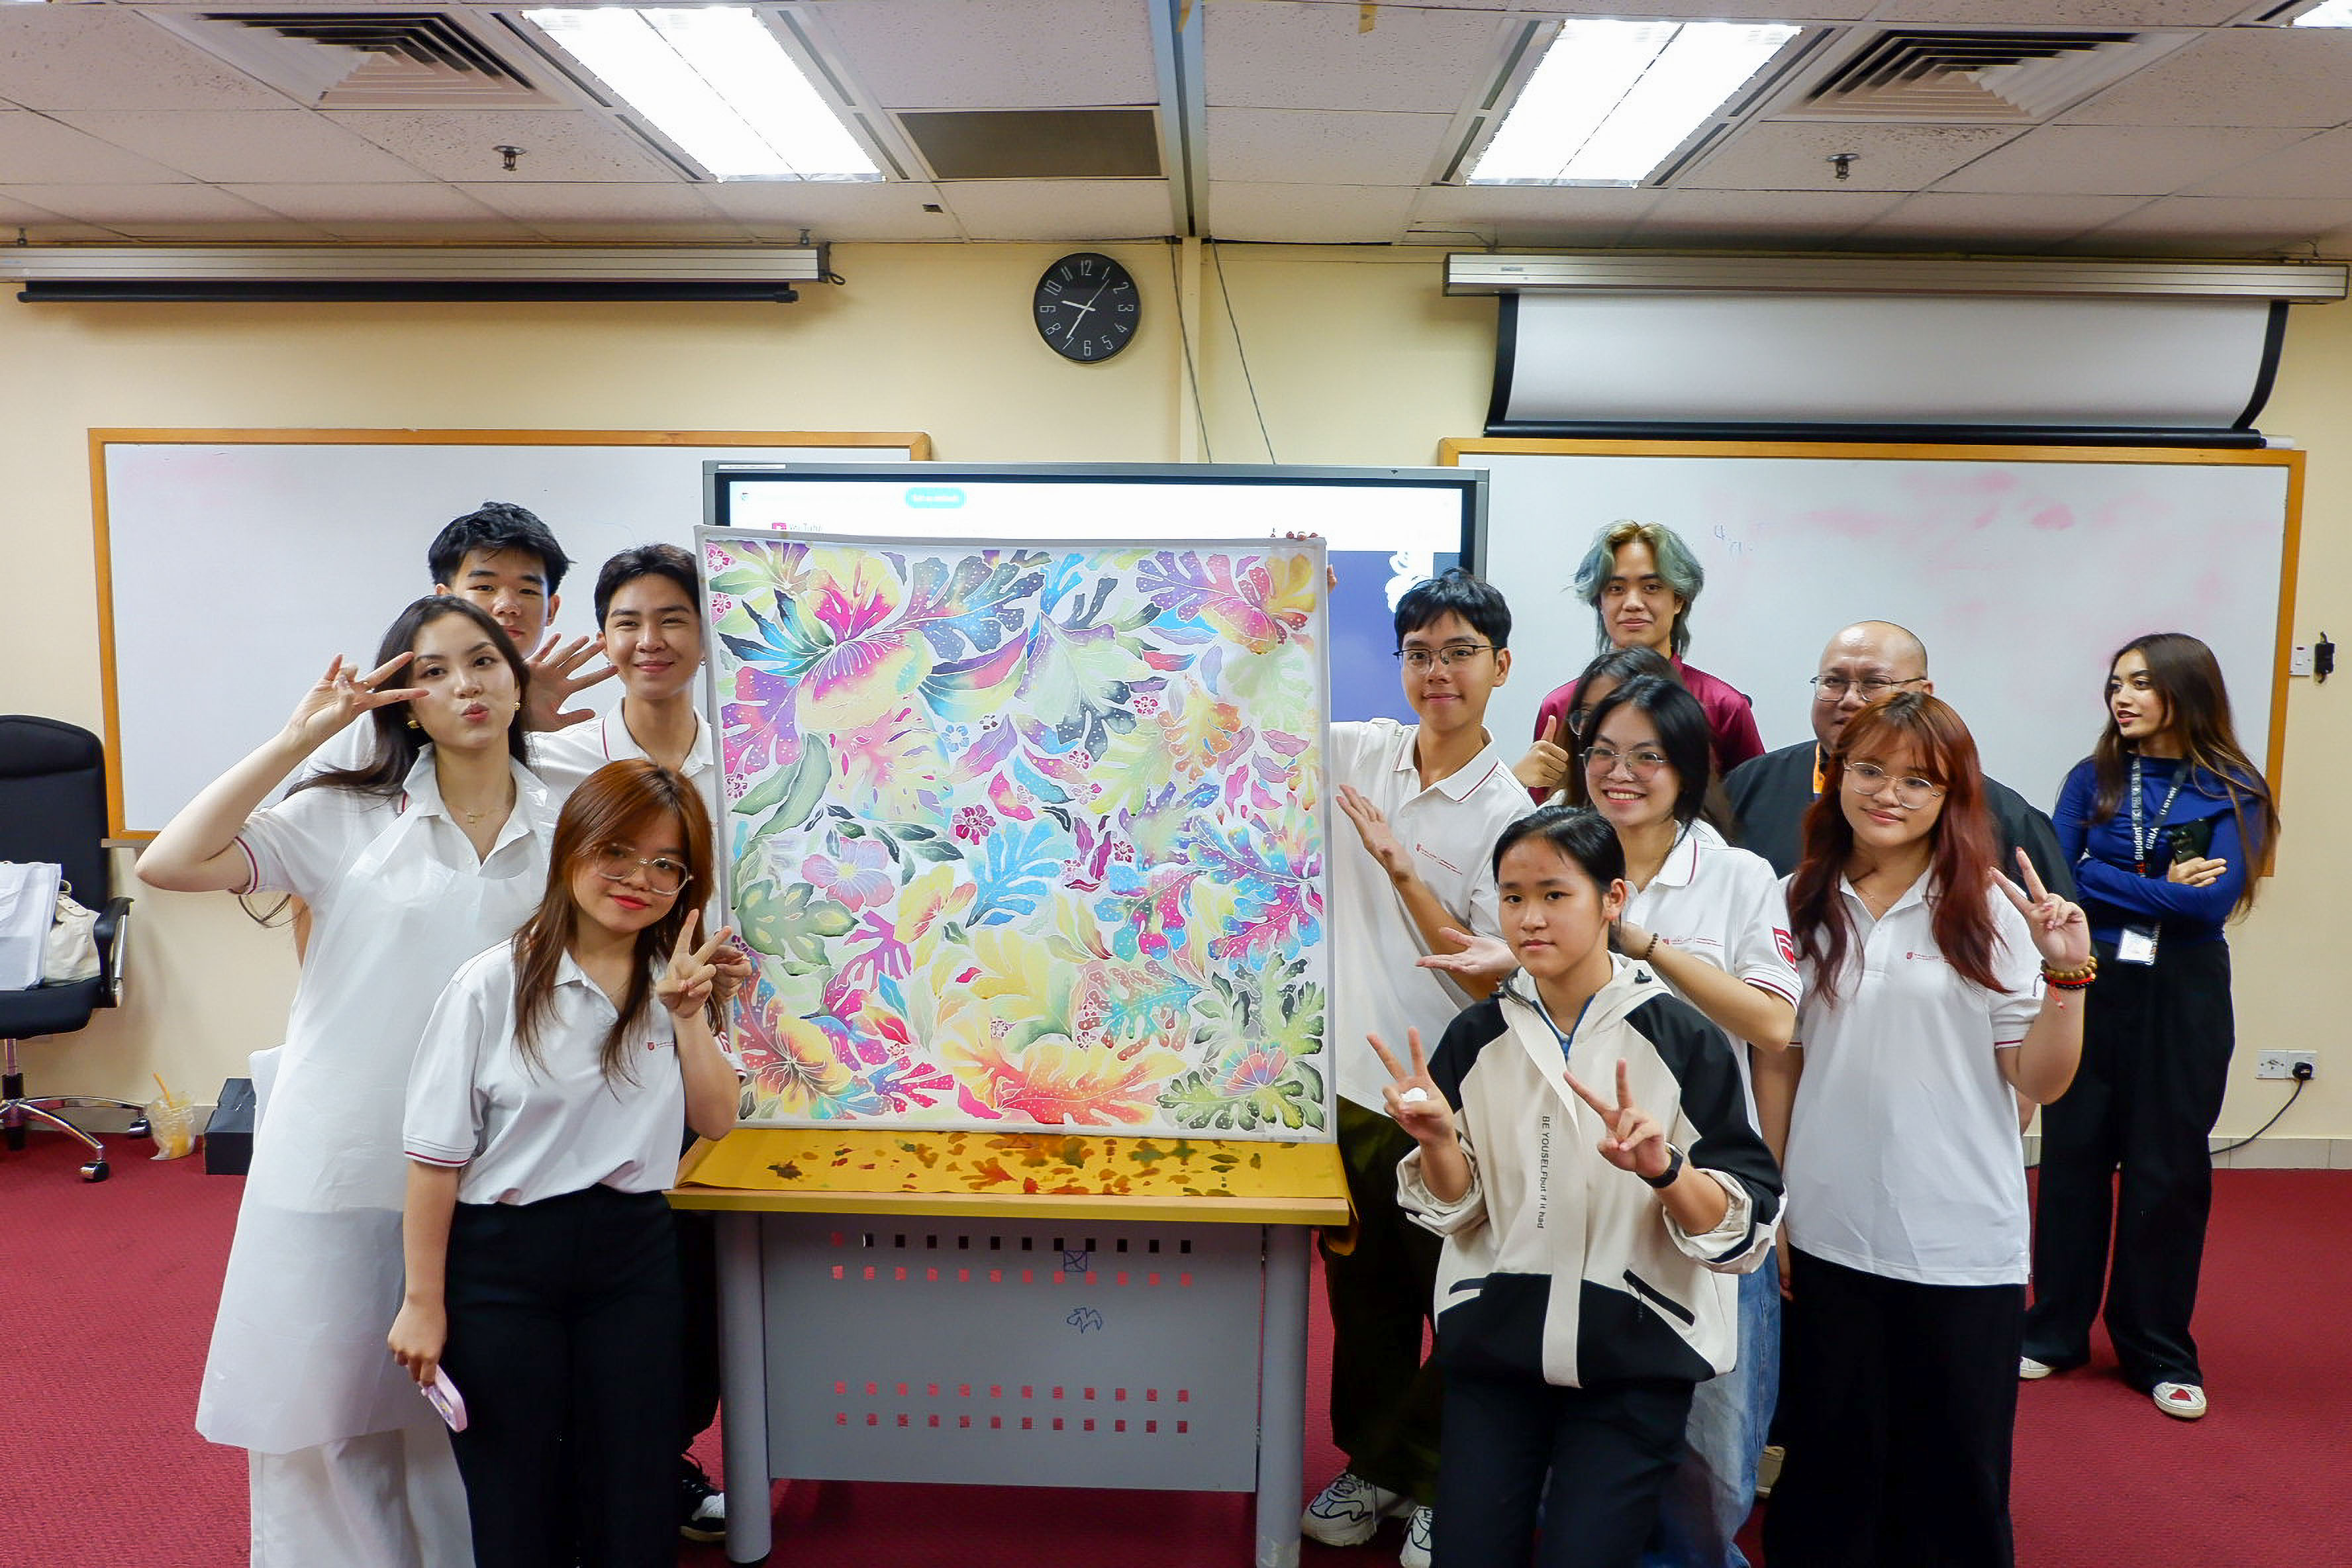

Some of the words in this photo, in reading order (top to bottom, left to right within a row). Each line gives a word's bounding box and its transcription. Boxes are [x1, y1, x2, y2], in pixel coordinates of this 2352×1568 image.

[1061, 266, 1073, 281] 11
[1081, 260, 1092, 276] 12
[1102, 266, 1110, 279] 1
[1044, 279, 1062, 296] 10
[1112, 281, 1129, 295] 2
[1045, 322, 1061, 336] 8
[1114, 322, 1128, 333] 4
[1061, 336, 1075, 350] 7
[1083, 340, 1091, 357] 6
[1101, 335, 1114, 350] 5
[1542, 1116, 1550, 1129] BE
